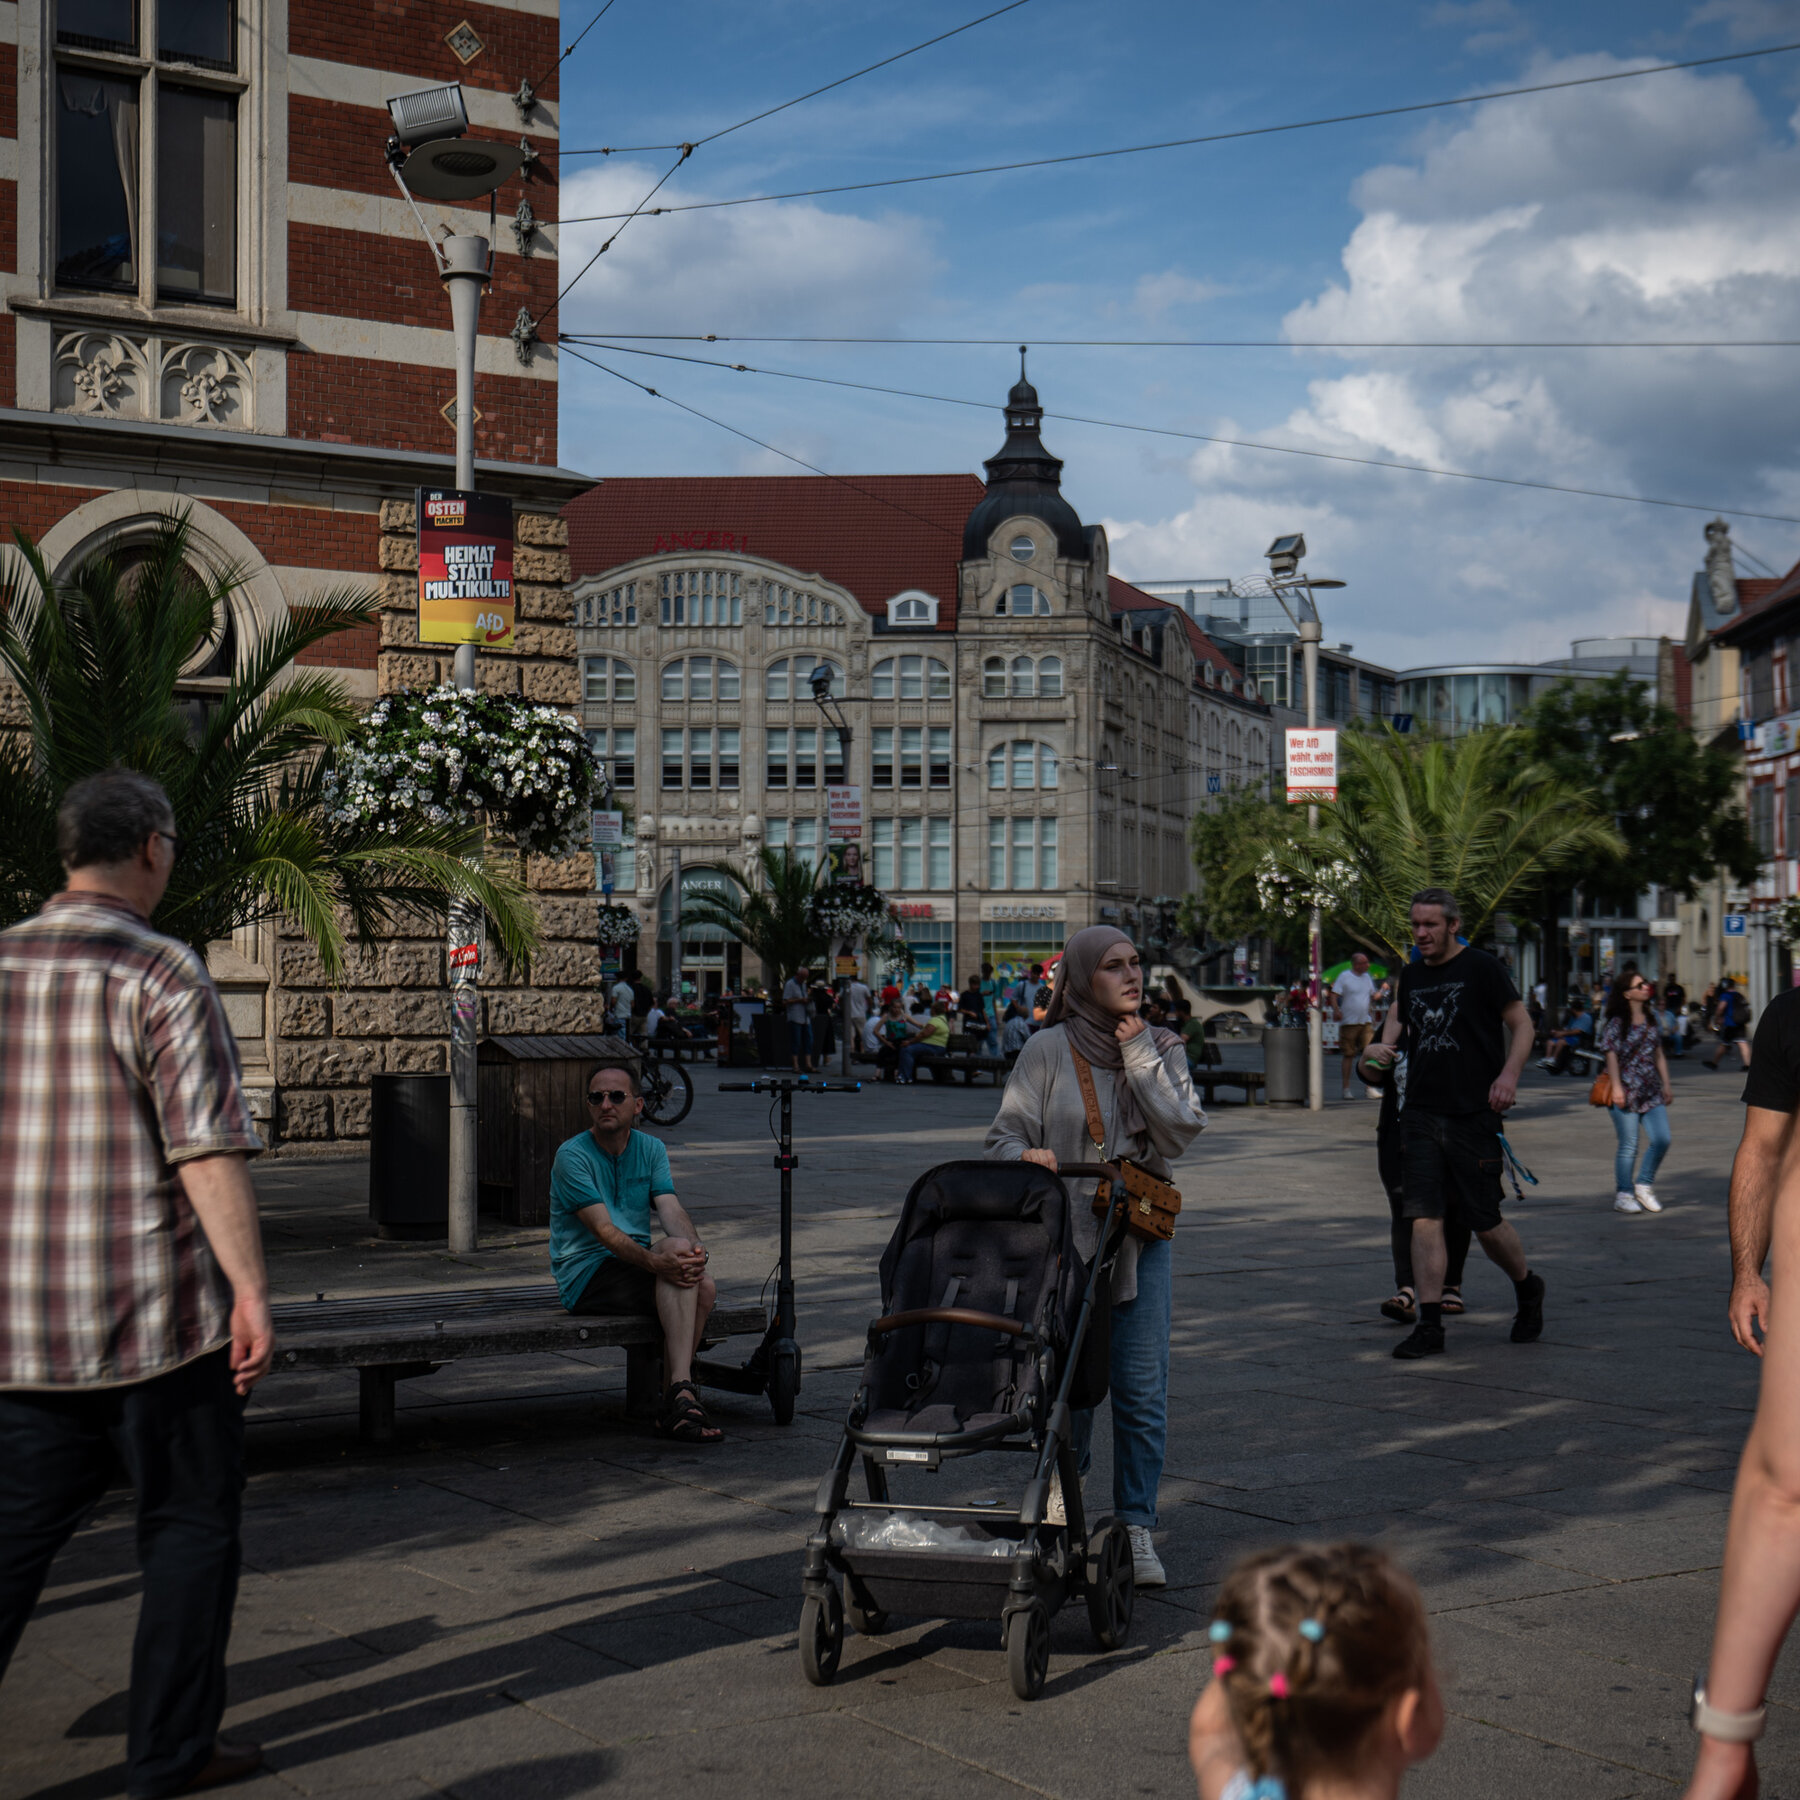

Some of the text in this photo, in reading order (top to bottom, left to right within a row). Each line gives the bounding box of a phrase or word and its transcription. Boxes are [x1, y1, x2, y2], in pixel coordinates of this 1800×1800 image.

[430, 493, 442, 501] DER
[428, 502, 464, 516] OSTEN
[653, 530, 735, 554] ANGER
[444, 545, 496, 564] HEIMAT
[448, 564, 493, 581] STATT
[425, 580, 510, 600] MULTIKULTI!
[475, 613, 504, 631] AfD
[1290, 738, 1319, 748] Wer AfD
[1290, 752, 1333, 763] wählt, wählt
[681, 880, 722, 889] ANGER
[992, 905, 1055, 917] DOUGLAS
